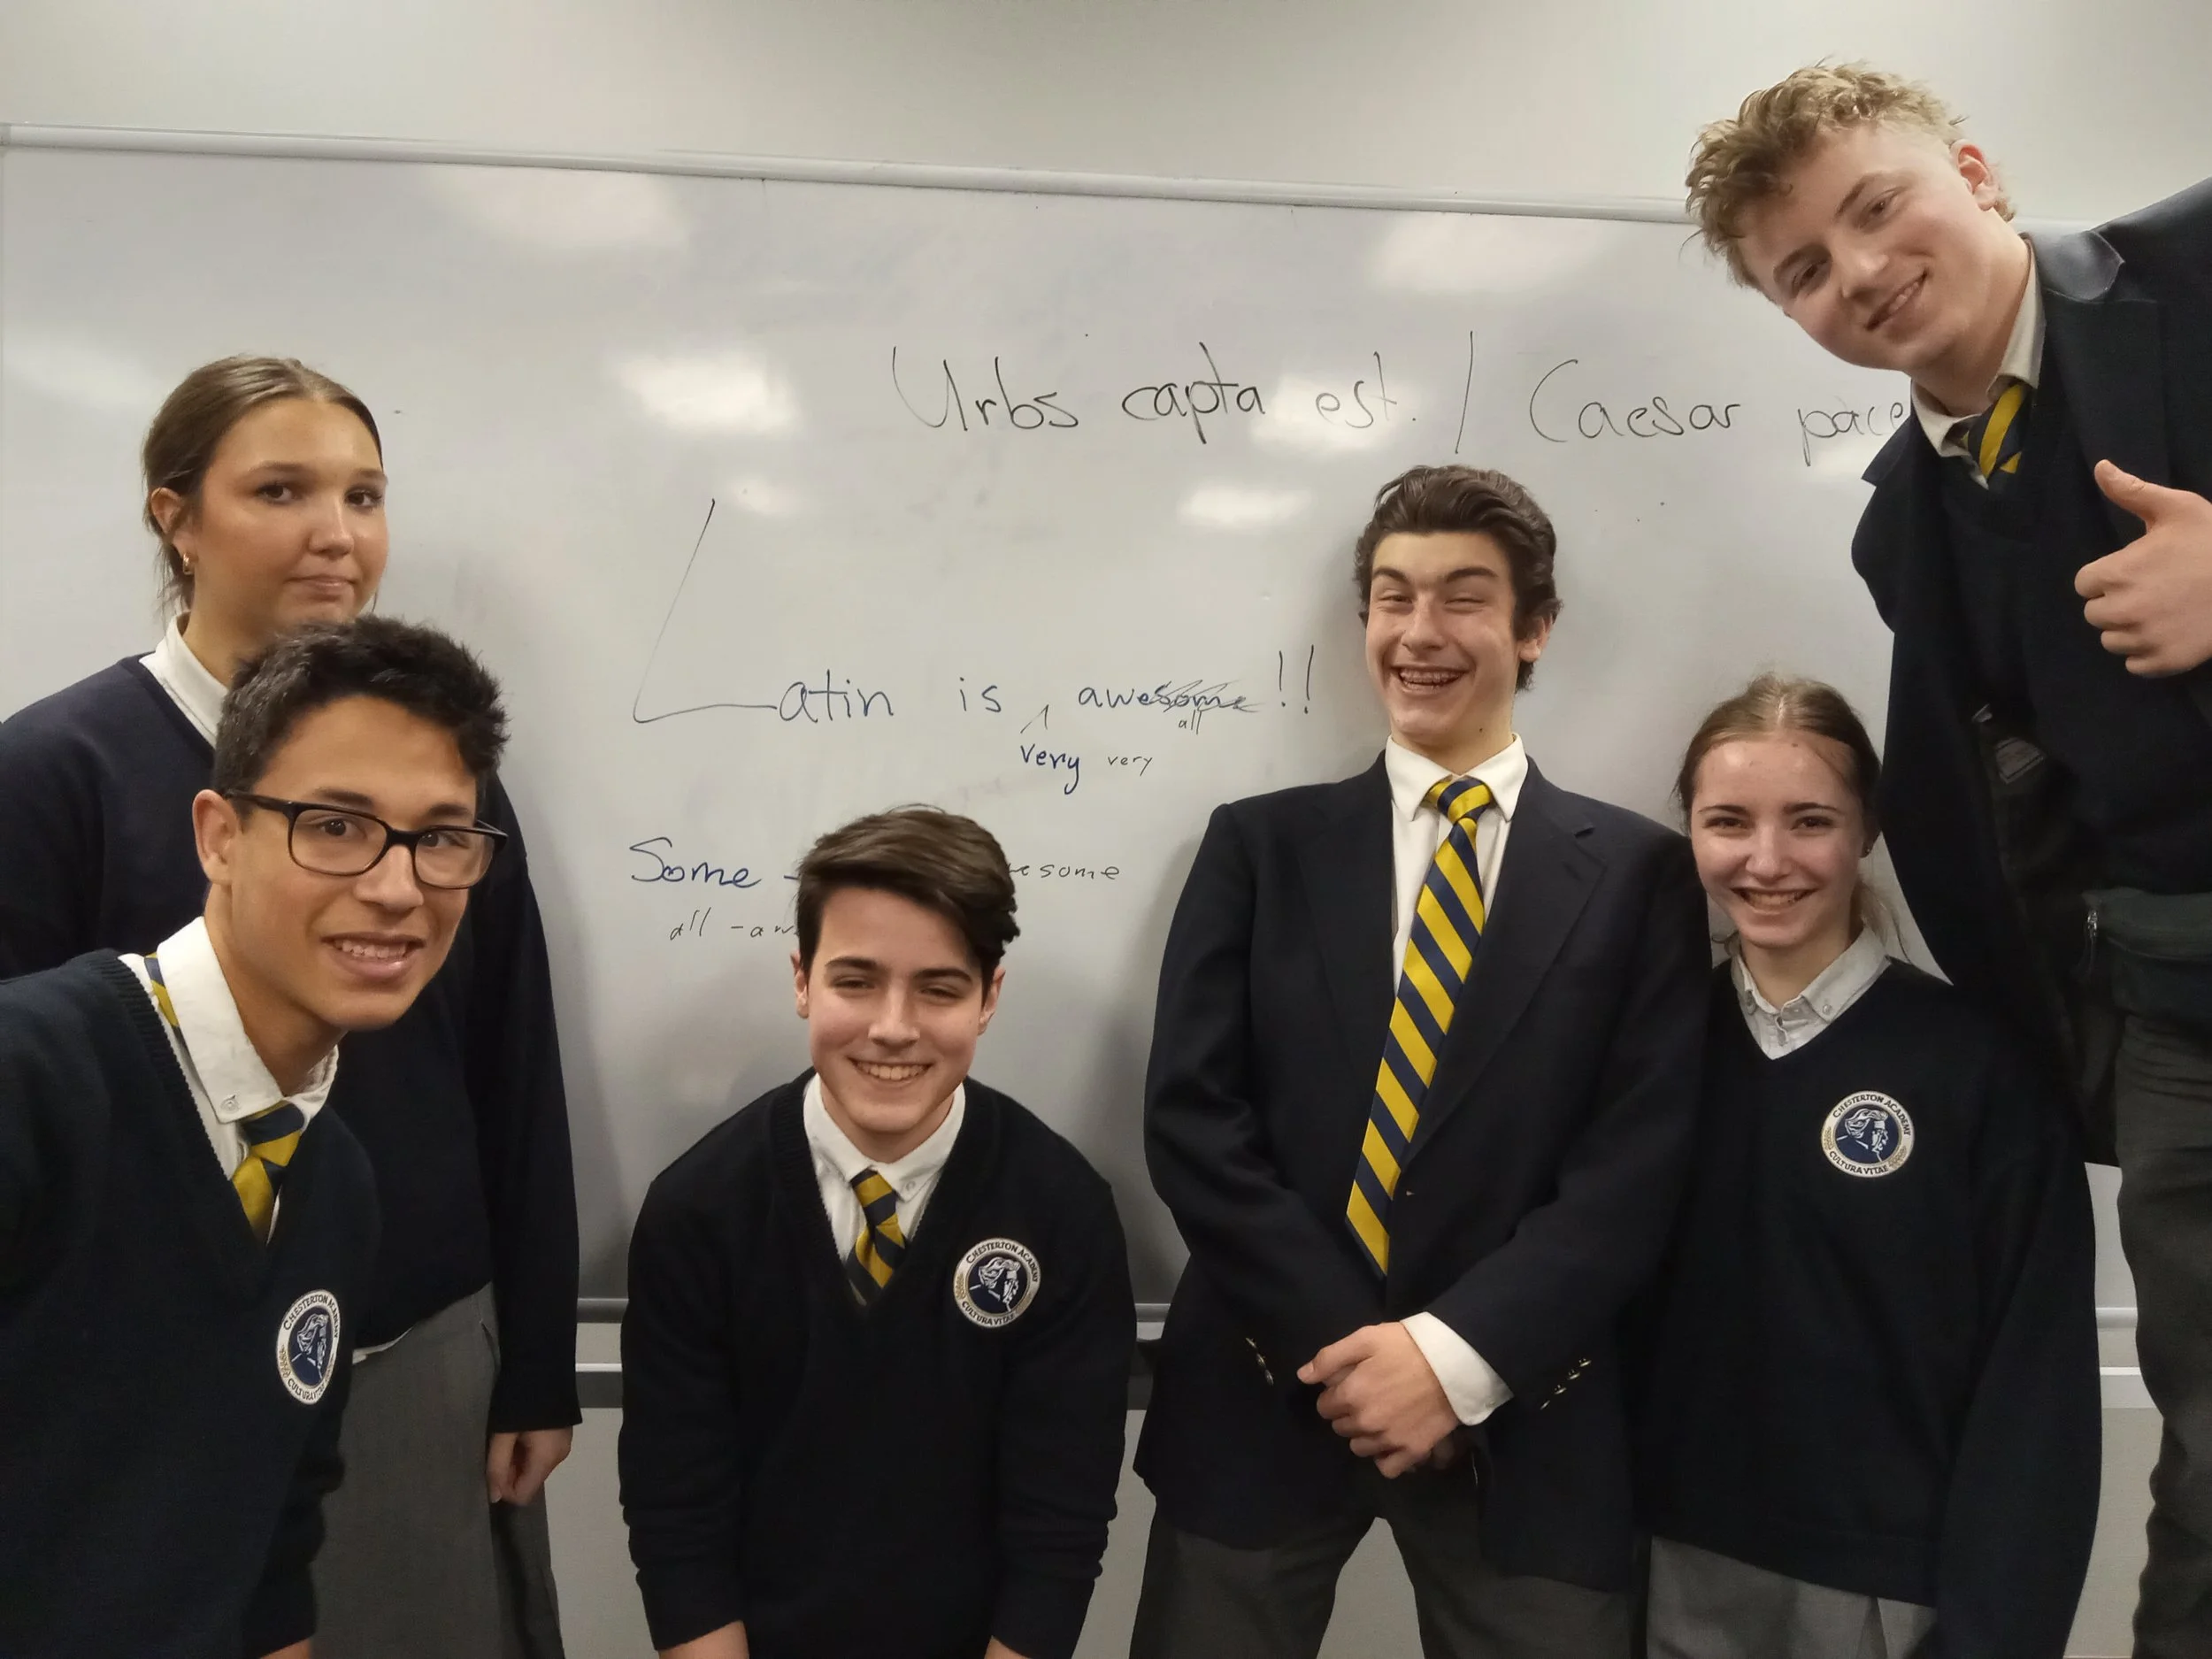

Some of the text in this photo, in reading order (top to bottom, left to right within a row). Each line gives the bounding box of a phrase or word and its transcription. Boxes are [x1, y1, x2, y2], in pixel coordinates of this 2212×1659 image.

[893, 346, 1079, 431] Urbs
[1122, 342, 1265, 444] capta
[1529, 357, 1741, 442] Caesar
[633, 497, 894, 724] Latin
[959, 677, 1002, 713] is
[1178, 709, 1203, 735] all
[1019, 743, 1154, 795] very very
[629, 836, 762, 888] Some
[669, 907, 712, 941] all
[1832, 1094, 1911, 1136] CHESTERTON ACADEMY
[1829, 1151, 1889, 1175] CULTURA VITAE
[966, 1240, 1039, 1283] CHESTERTON ACADEMY
[283, 1294, 328, 1331] CHESTERTON
[962, 1301, 993, 1325] CULTURA
[288, 1378, 314, 1401] CULTURA
